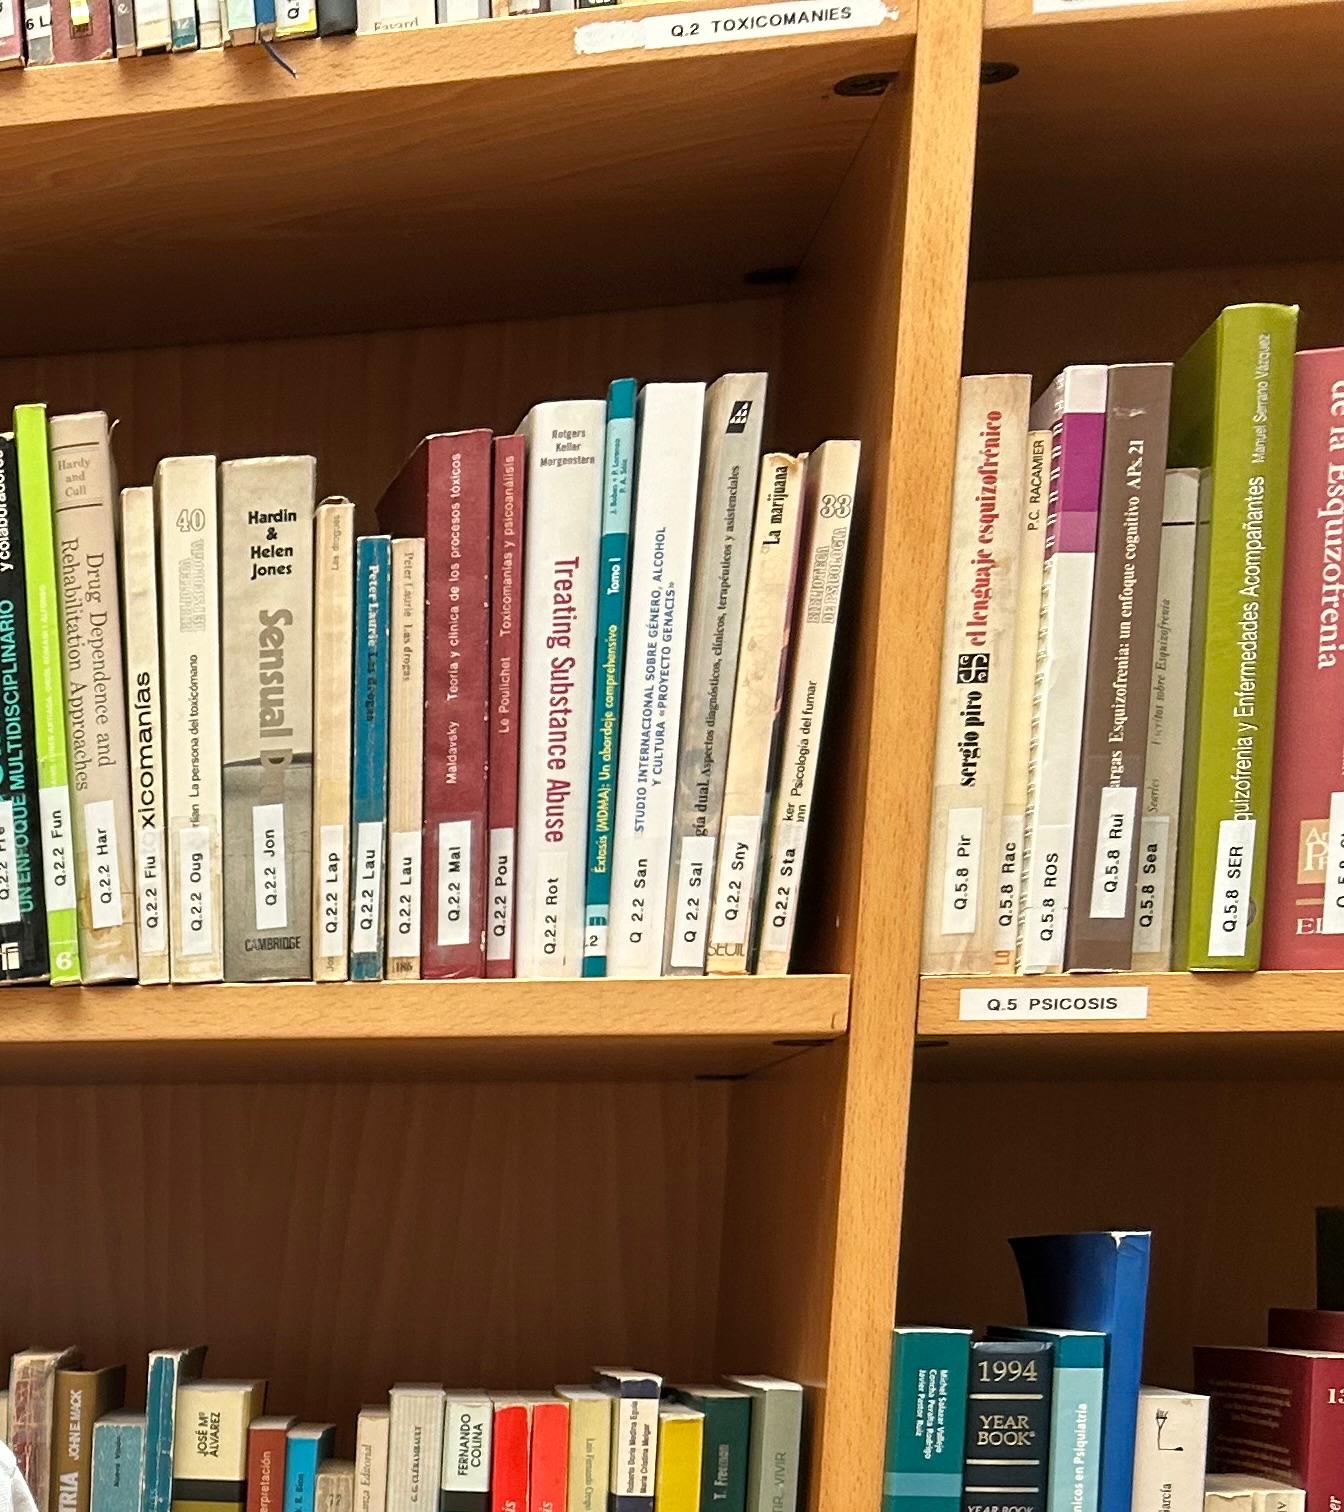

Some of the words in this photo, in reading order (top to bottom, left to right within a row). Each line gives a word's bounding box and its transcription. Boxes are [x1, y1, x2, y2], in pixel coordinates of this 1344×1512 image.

[671, 20, 700, 38] Q.2
[712, 5, 852, 33] TOXICOMANIES
[975, 410, 1002, 547] esquizofrénico
[1028, 439, 1045, 503] RACAMIER
[175, 509, 205, 532] 40
[247, 509, 297, 525] Hardin
[265, 526, 277, 541] &
[1026, 507, 1039, 532] P.C.
[1238, 475, 1266, 596] Acompañantes
[250, 546, 293, 559] Helen
[250, 563, 292, 578] Jones
[85, 552, 104, 604] Drug
[970, 548, 994, 626] lenguaje
[61, 538, 84, 674] Rehabilitation
[546, 556, 580, 649] Treating
[970, 627, 989, 646] el
[88, 607, 110, 718] Dependence
[257, 608, 293, 739] Sensual
[1233, 602, 1258, 718] Enfermedades
[545, 656, 576, 769] Substance
[961, 690, 983, 726] piro
[1237, 721, 1254, 733] y
[70, 680, 88, 791] Approaches
[95, 731, 116, 768] and
[960, 727, 980, 787] sergio
[545, 779, 565, 843] Abuse
[262, 829, 275, 859] Jon
[447, 845, 460, 878] Mal
[1226, 845, 1242, 876] SER
[264, 867, 277, 906] Q.2.2
[448, 884, 461, 923] Q.2.2
[1222, 884, 1238, 933] Q.5.8
[244, 937, 301, 951] CAMBRIDGE
[987, 998, 1017, 1013] Q.5
[1030, 997, 1118, 1012] PSICOSIS
[978, 1359, 1038, 1384] 1994
[196, 1425, 208, 1457] JOSÉ
[209, 1412, 221, 1457] ALVAREZ
[979, 1414, 1031, 1430] YEAR
[457, 1413, 470, 1477] FERNANDO
[470, 1422, 483, 1468] COLINA
